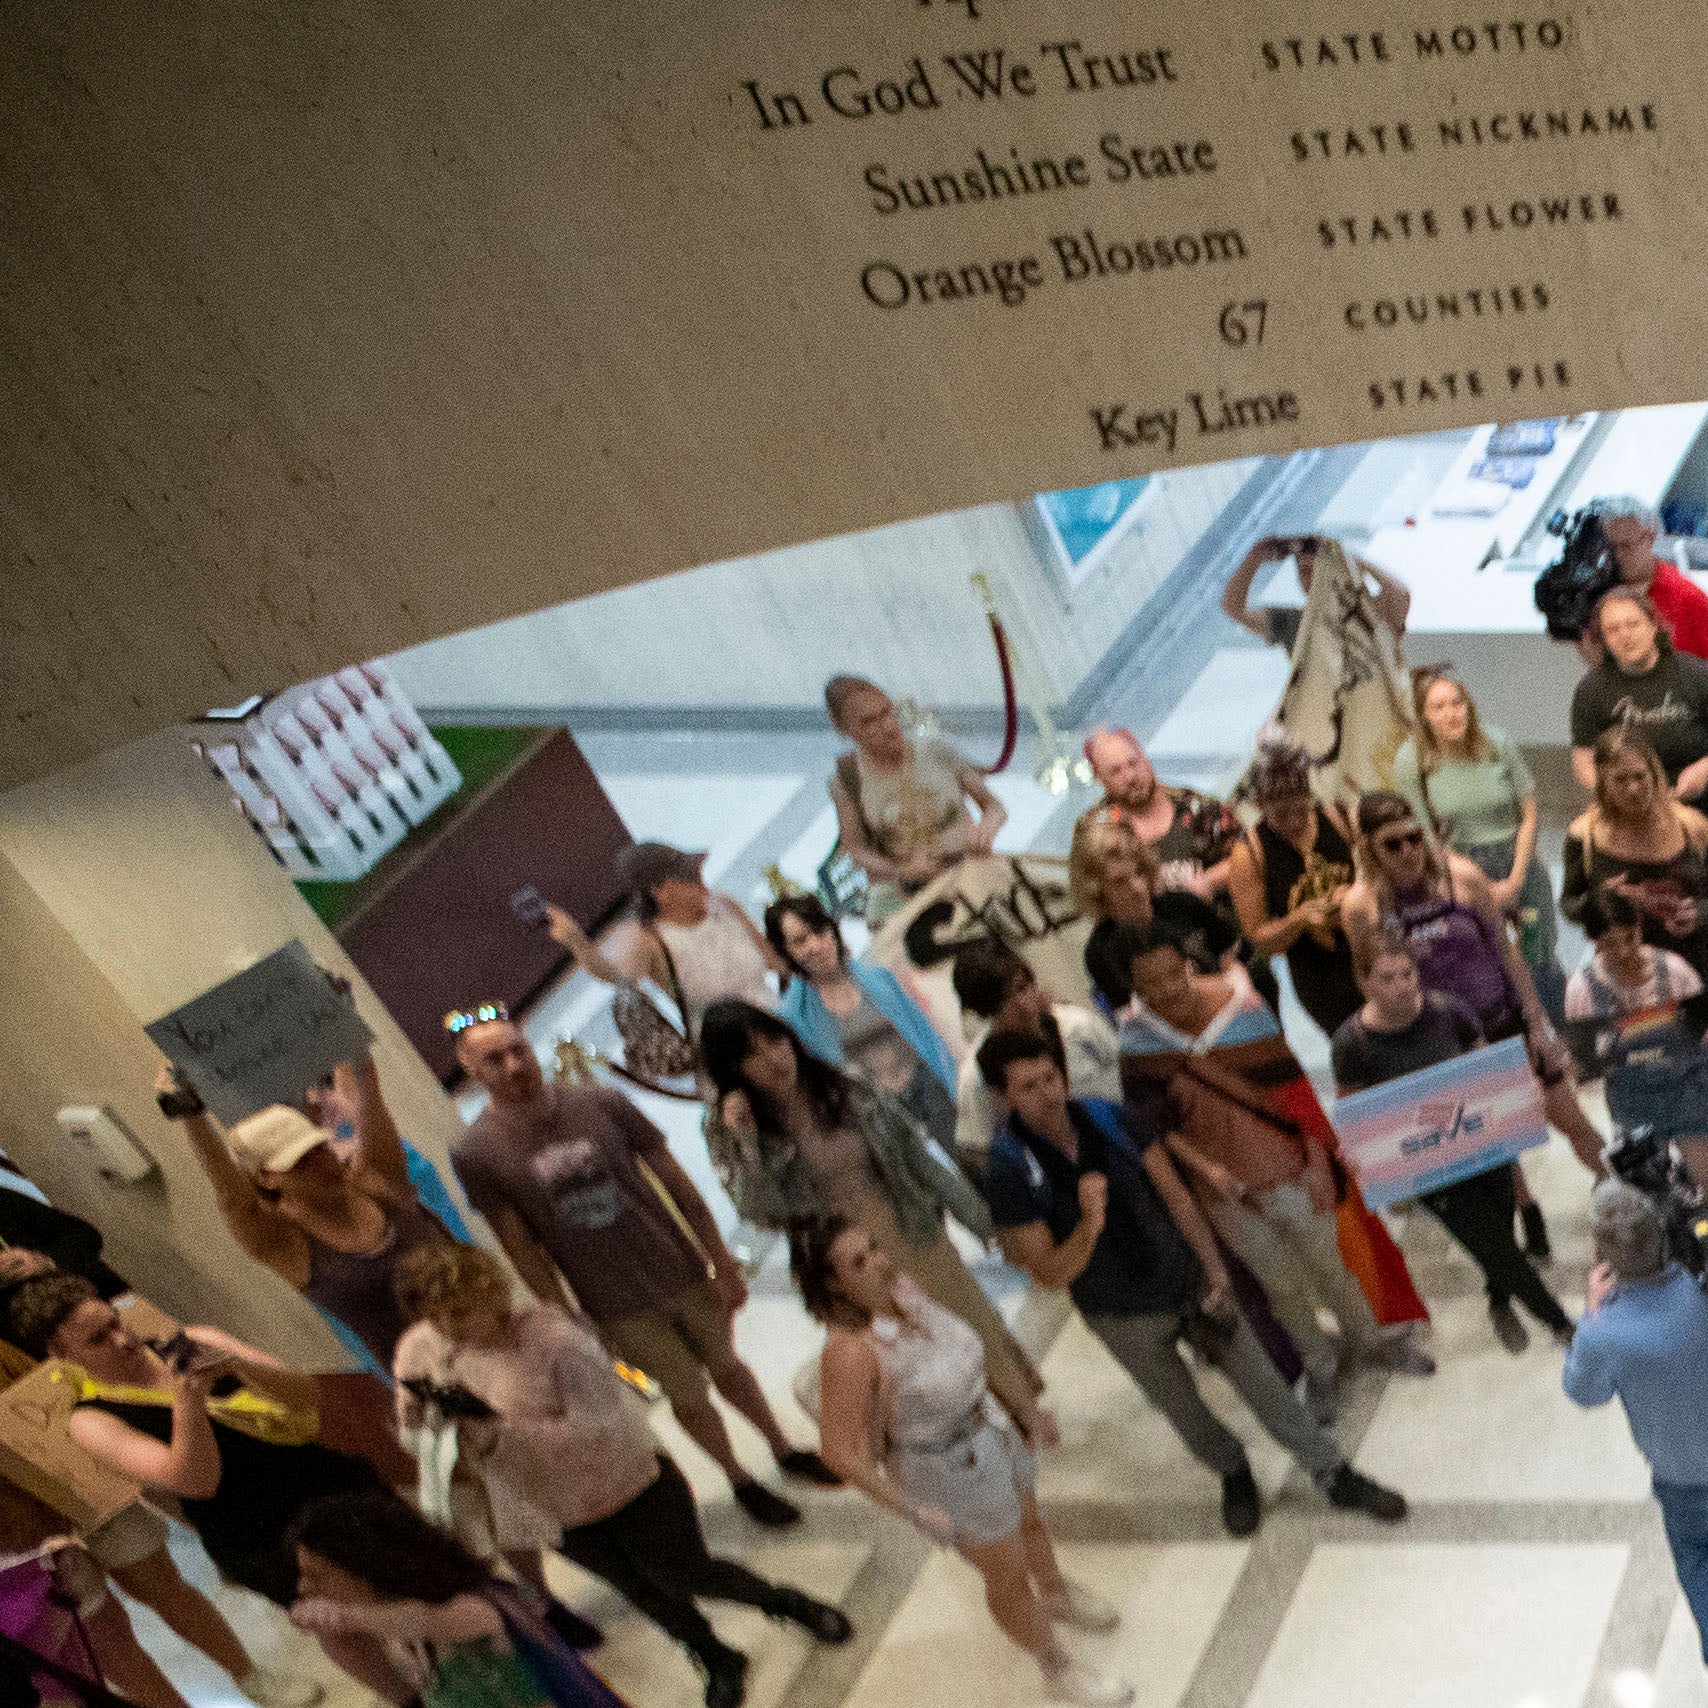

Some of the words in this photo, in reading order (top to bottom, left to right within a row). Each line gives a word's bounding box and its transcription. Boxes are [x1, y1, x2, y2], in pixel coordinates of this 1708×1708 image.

[1261, 35, 1392, 72] STATE
[1413, 19, 1565, 61] MOTTO
[742, 77, 811, 131] In
[820, 61, 938, 122] God
[942, 51, 1038, 103] We
[1040, 42, 1178, 94] Trust
[1289, 125, 1418, 162] STATE
[1439, 103, 1660, 148] NICKNAME
[864, 145, 1090, 214] Sunshine
[1103, 133, 1217, 183] State
[1317, 208, 1440, 248] STATE
[1462, 194, 1623, 234] FLOWER
[860, 255, 1043, 309] Orange
[1052, 222, 1248, 284] Blossom
[1217, 302, 1271, 349] 67
[1343, 284, 1553, 330] COUNTIES
[1367, 368, 1487, 408] STATE
[1507, 359, 1572, 394] PIE
[1089, 405, 1180, 451] Key
[1198, 384, 1301, 435] Lime
